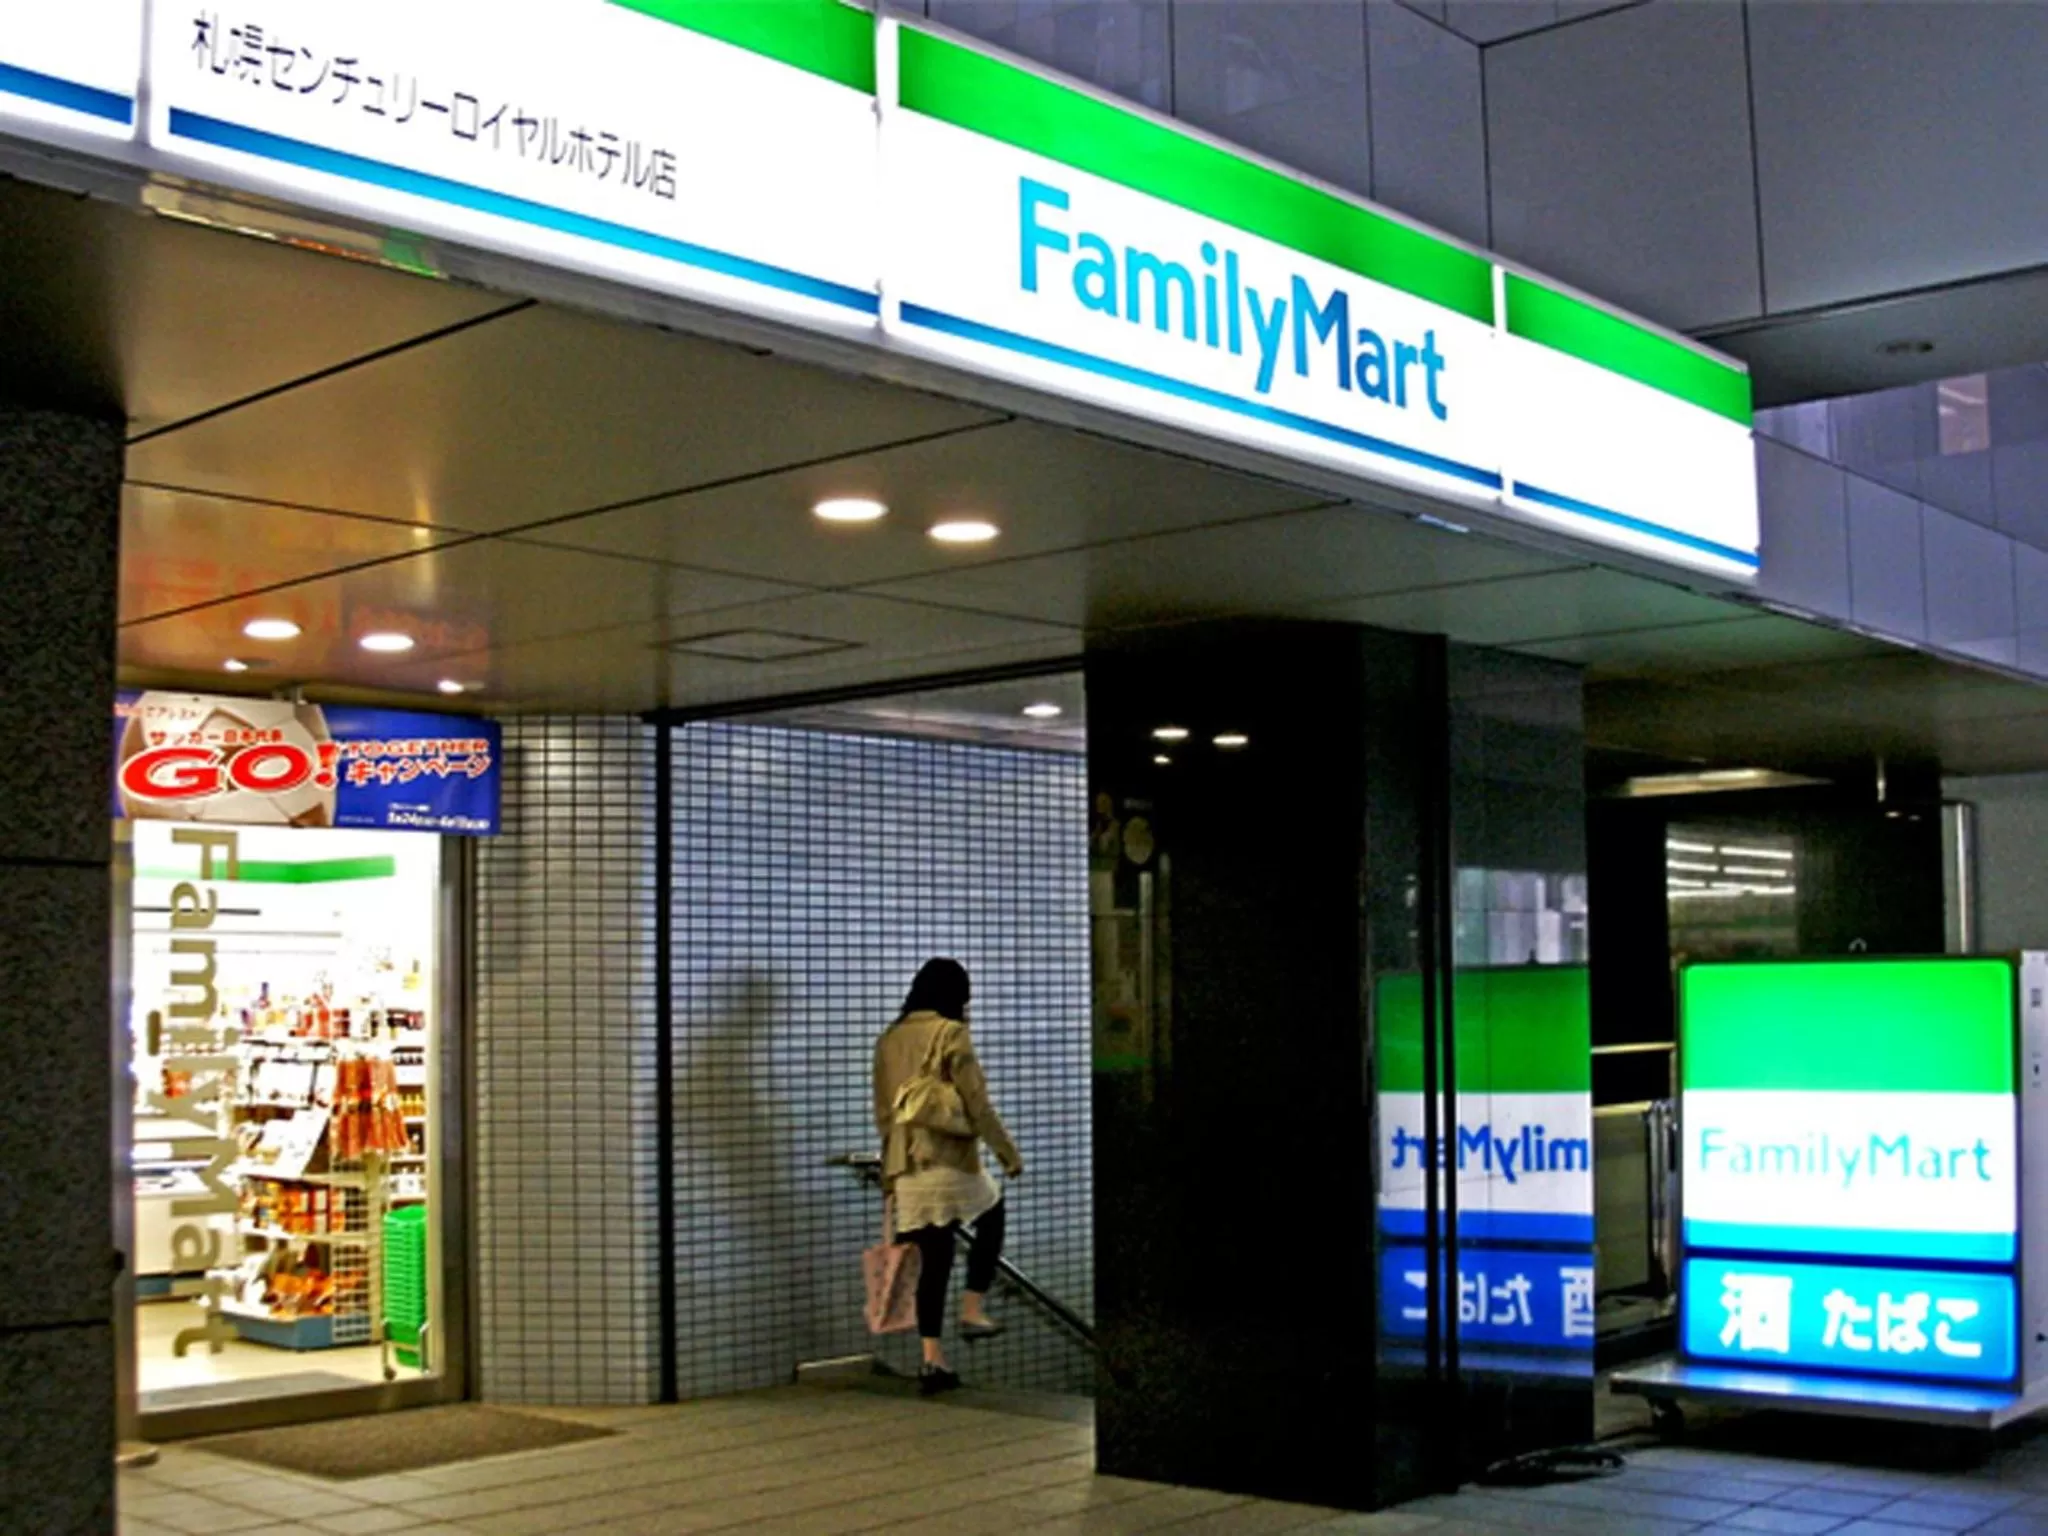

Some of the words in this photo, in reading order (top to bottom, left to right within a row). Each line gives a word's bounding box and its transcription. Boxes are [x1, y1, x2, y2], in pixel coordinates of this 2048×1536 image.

[191, 9, 678, 200] 札幌センチュリーロイヤルホテル店
[1018, 175, 1448, 422] FamilyMart
[121, 743, 338, 800] GO!
[149, 827, 241, 1358] FamilyMart
[1699, 1126, 1992, 1188] FamilyMart
[1719, 1271, 1793, 1354] 酒
[1822, 1288, 1983, 1358] たばこ
